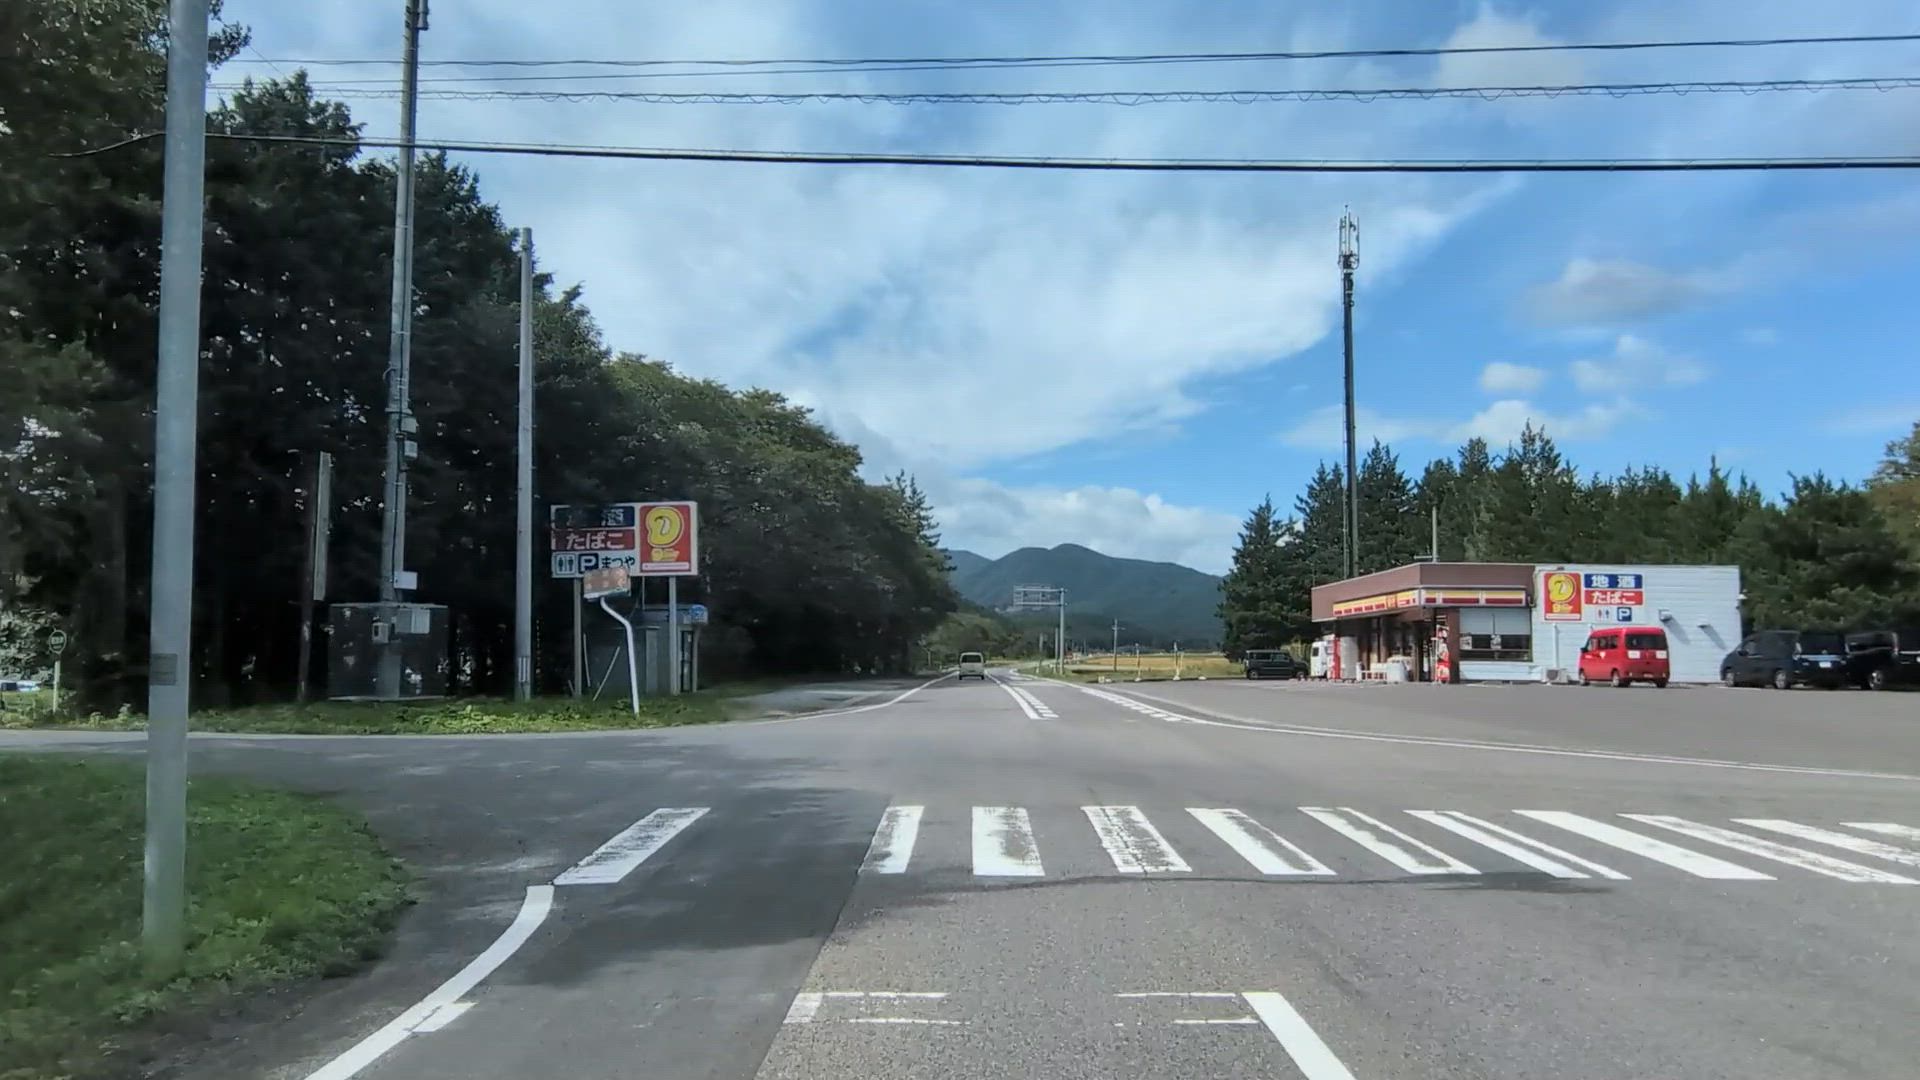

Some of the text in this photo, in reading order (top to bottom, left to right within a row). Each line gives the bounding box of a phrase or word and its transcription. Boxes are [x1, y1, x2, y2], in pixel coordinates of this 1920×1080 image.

[566, 530, 625, 549] たばこ
[580, 556, 635, 571] P まつや
[1591, 575, 1636, 588] 地酒
[1591, 591, 1636, 604] たばこ
[1618, 608, 1631, 620] P
